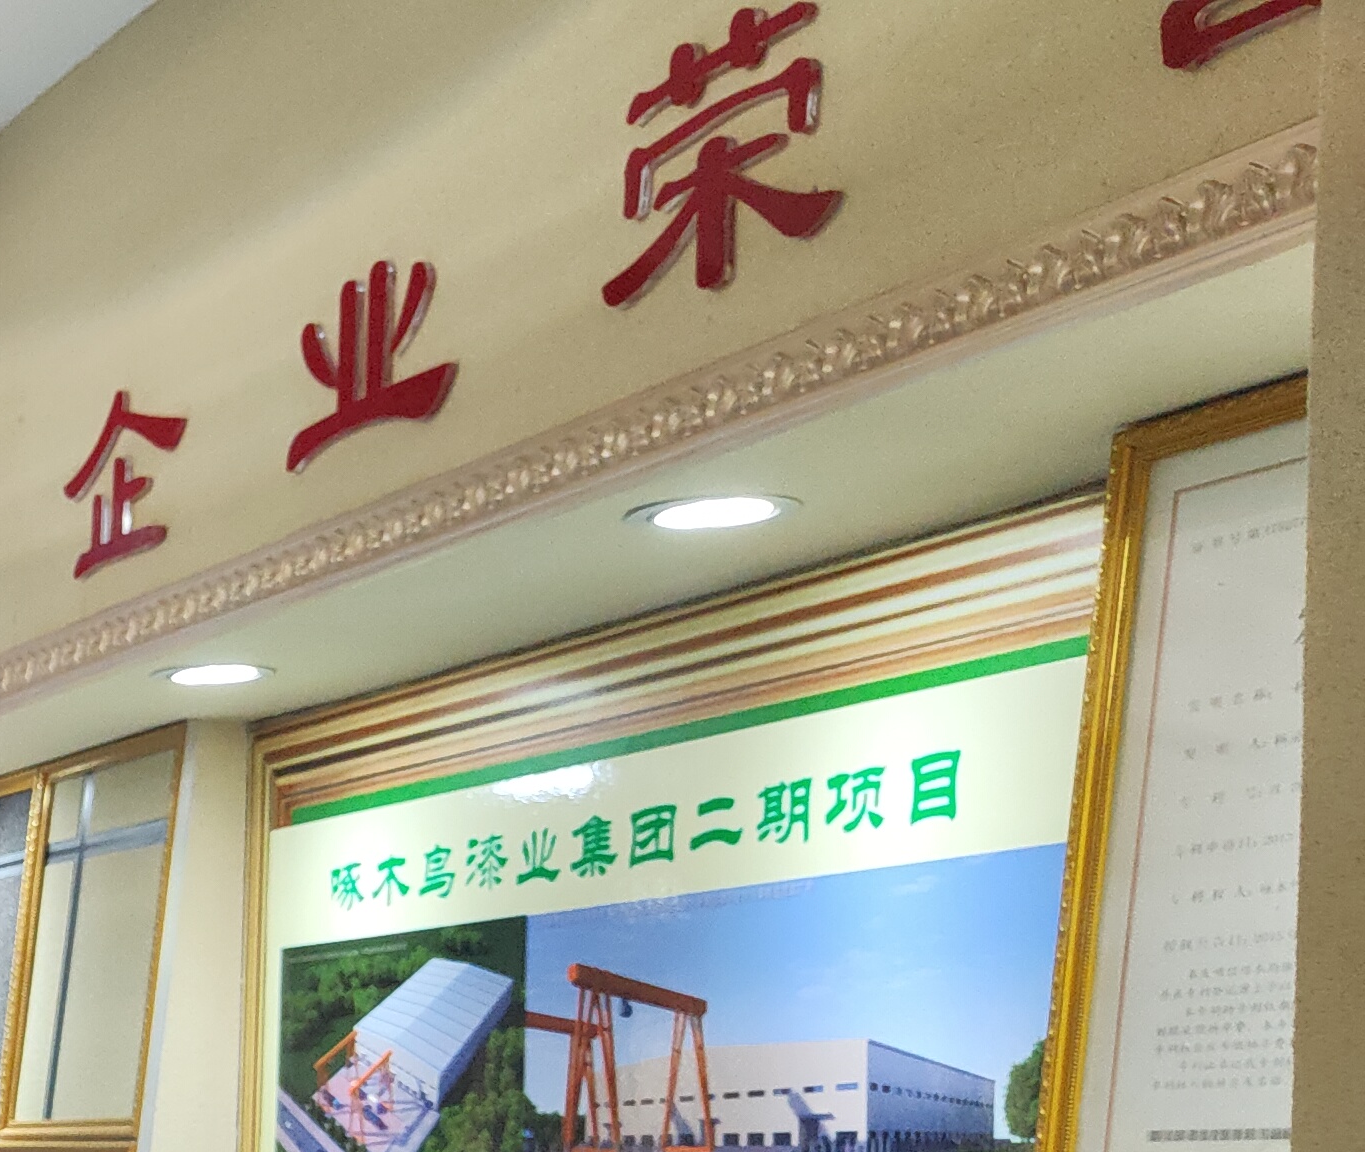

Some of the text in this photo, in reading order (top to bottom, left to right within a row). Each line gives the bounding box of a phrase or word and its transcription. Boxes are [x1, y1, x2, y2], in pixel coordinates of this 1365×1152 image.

[330, 748, 963, 913] 啄木鸟漆业集团二期项目
